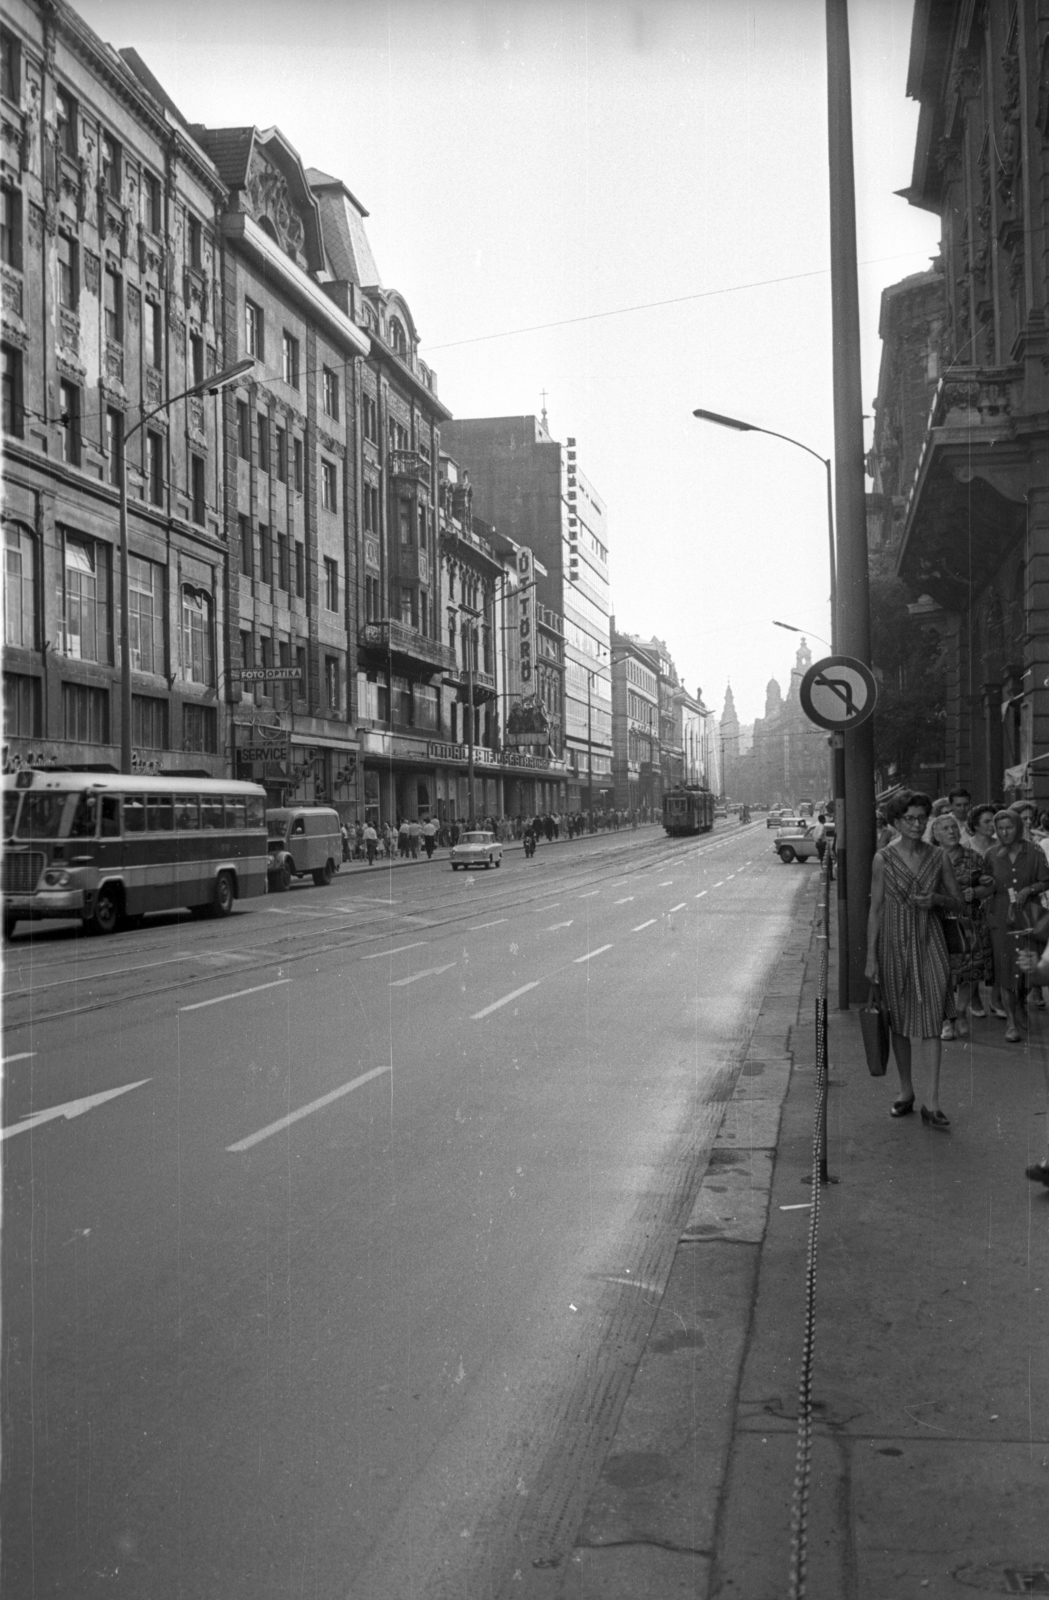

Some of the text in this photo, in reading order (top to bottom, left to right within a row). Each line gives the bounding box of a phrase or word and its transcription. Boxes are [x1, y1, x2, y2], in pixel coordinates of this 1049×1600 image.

[241, 669, 300, 679] FOTO OPTIKA
[242, 747, 287, 761] SERVICE
